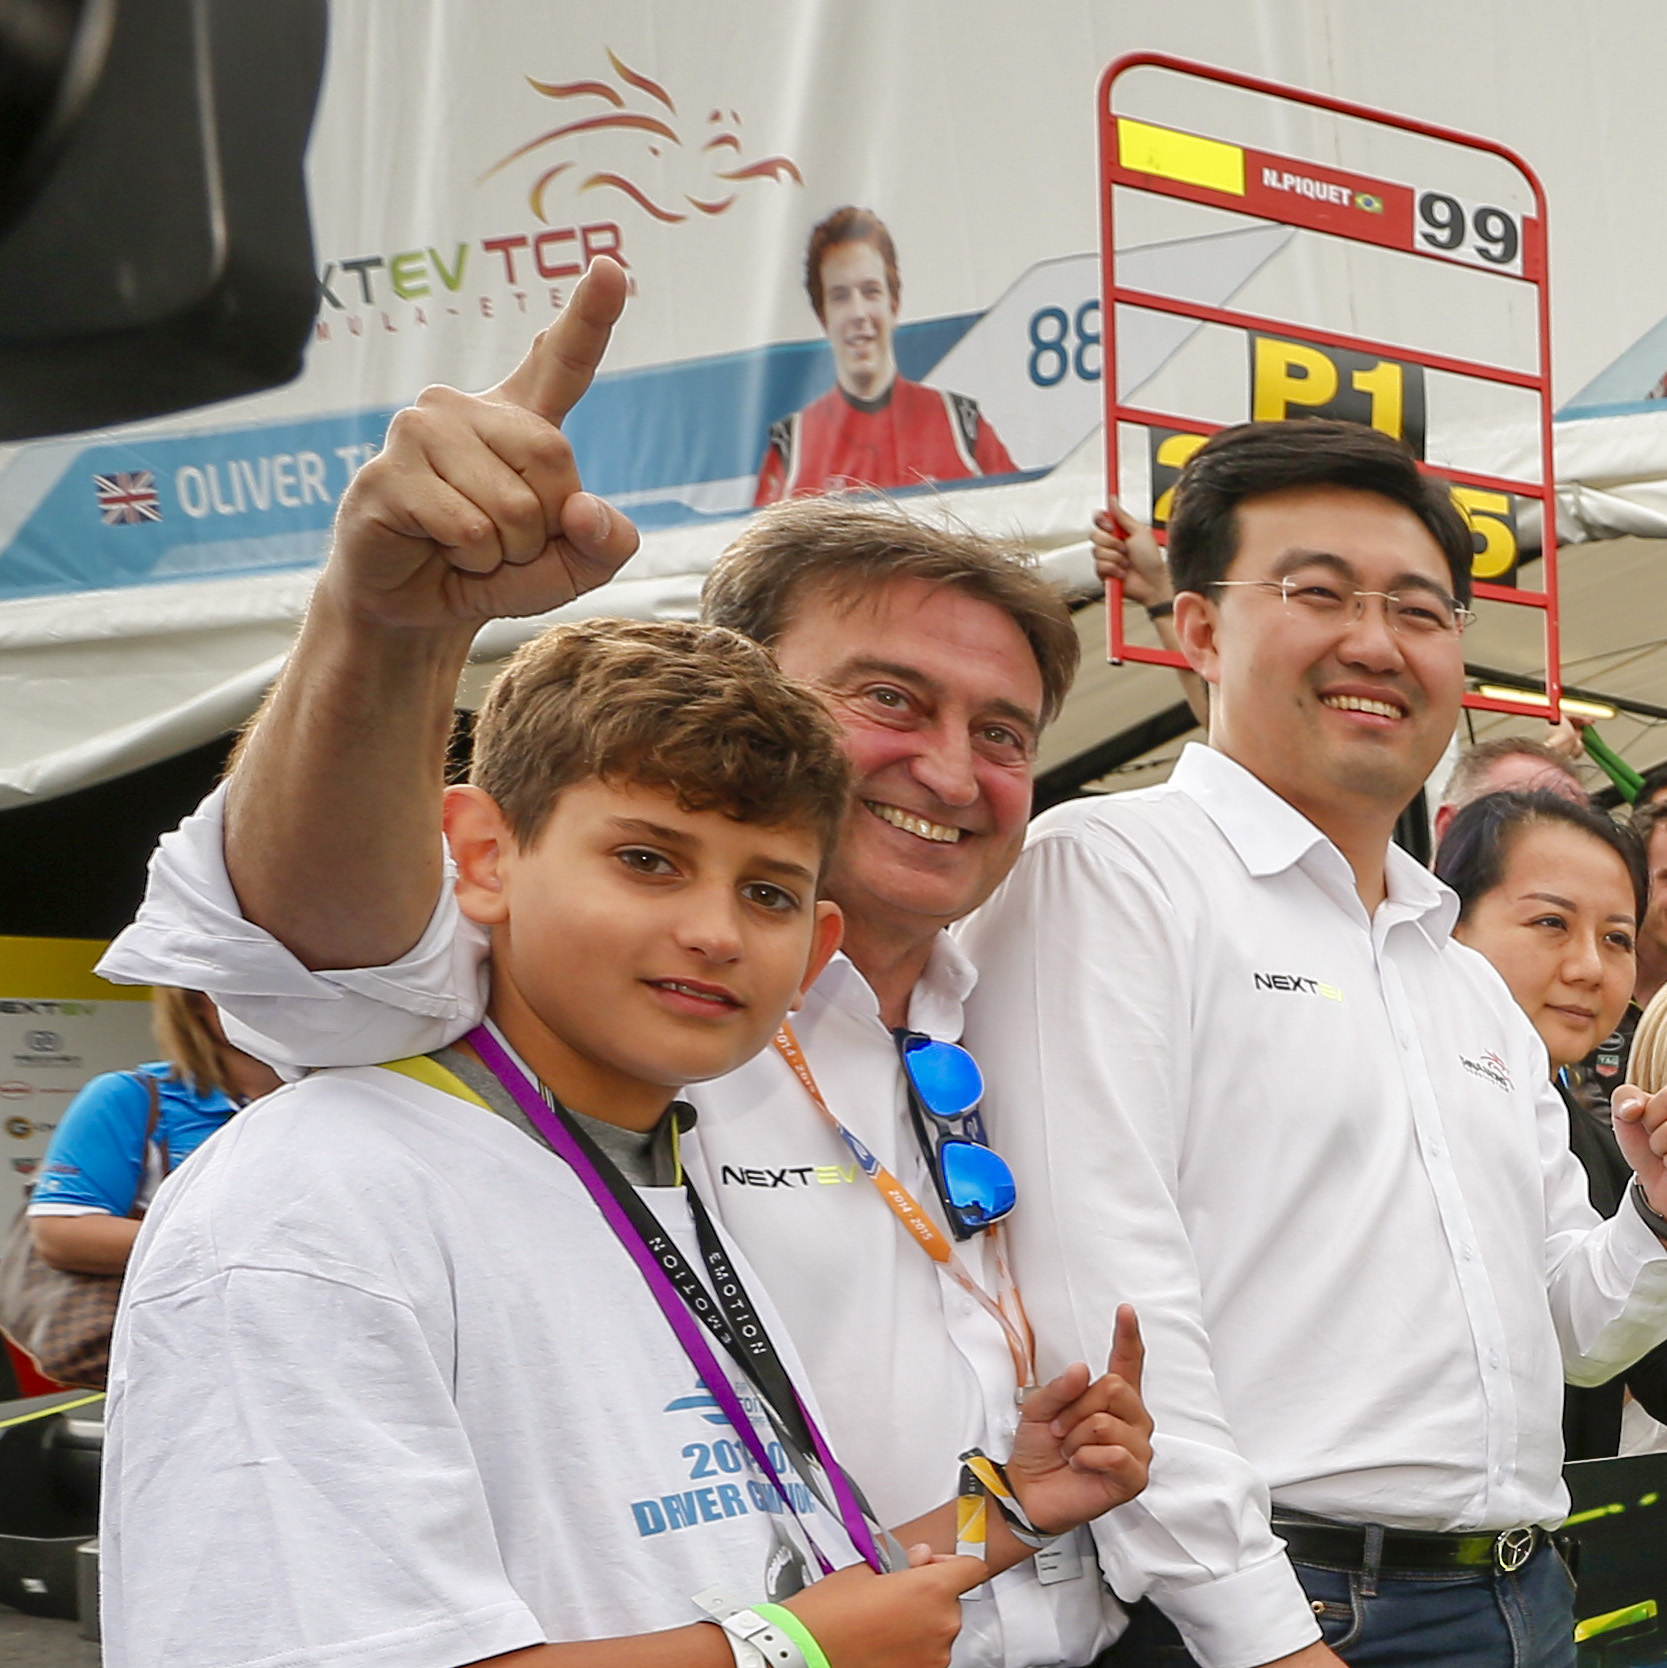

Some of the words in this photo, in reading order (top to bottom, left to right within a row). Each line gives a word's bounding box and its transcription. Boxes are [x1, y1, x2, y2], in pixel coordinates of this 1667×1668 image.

[1417, 190, 1520, 265] 99
[1026, 299, 1102, 387] 88
[1253, 336, 1404, 438] P1
[175, 450, 331, 518] OLIVER
[720, 1163, 859, 1188] NEXTEV
[708, 1251, 767, 1356] EMOTION
